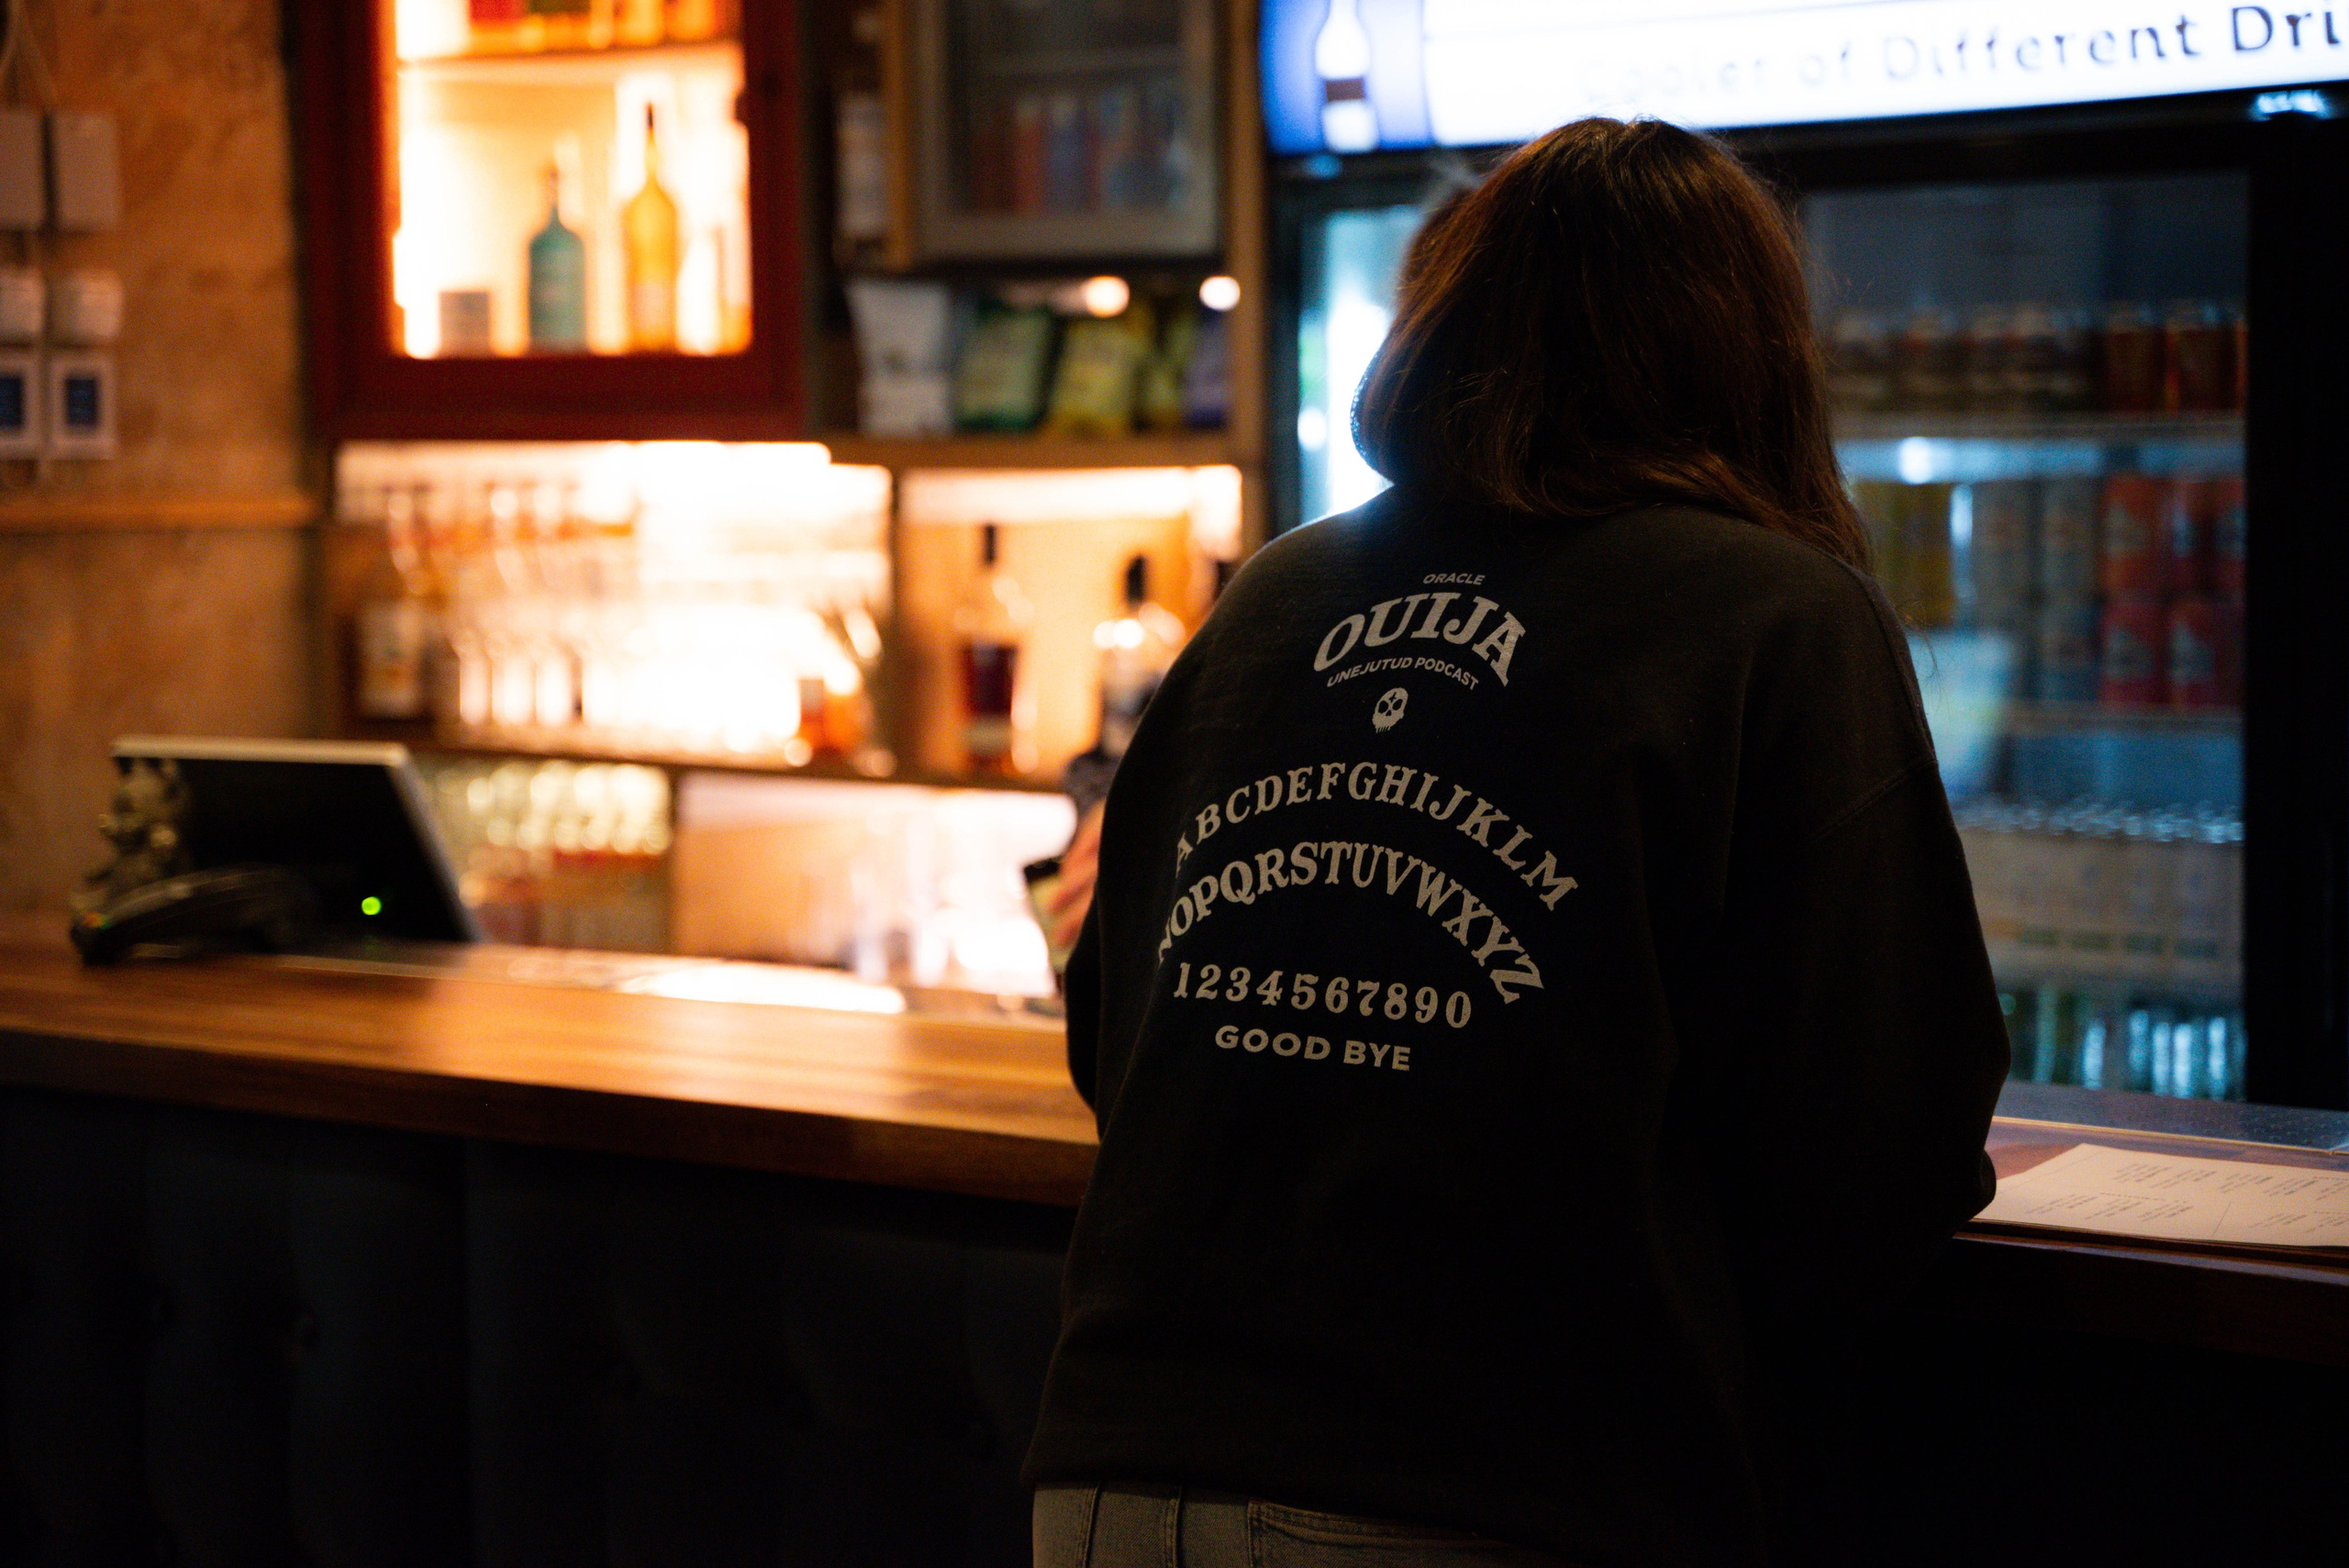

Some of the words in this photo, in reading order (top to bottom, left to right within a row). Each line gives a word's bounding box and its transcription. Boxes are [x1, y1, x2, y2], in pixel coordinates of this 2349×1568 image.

[1795, 37, 1854, 90] of
[1881, 15, 2205, 83] Different
[1423, 573, 1486, 586] ORACLE
[1313, 592, 1526, 687] OUIJA
[1327, 657, 1412, 687] UNEJUTUD
[1414, 657, 1479, 690] PODCAST
[1174, 962, 1472, 1029] 1234567890
[1215, 1025, 1330, 1061] GOOD
[1343, 1040, 1411, 1072] BYE
